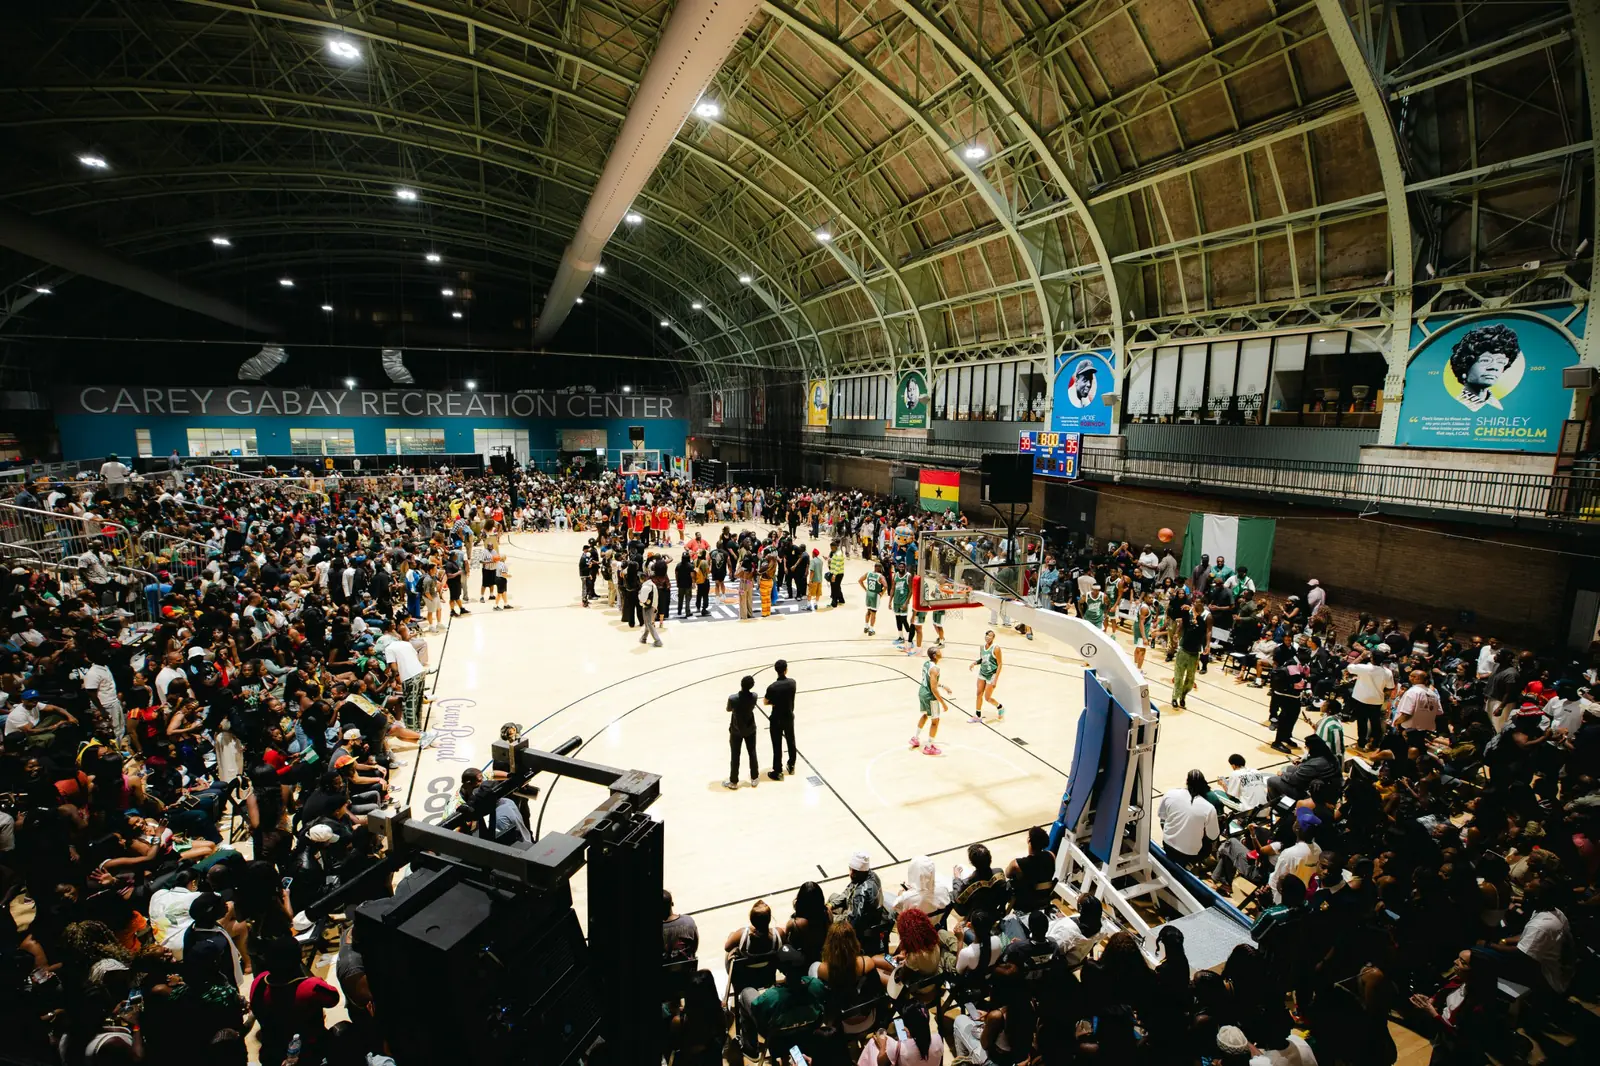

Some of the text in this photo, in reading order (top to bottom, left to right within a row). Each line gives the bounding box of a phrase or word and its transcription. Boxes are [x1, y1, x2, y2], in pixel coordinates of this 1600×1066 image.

[79, 387, 674, 418] CAREY GABAY RECREATION CENTER
[1476, 416, 1531, 426] SHIRLEY
[1474, 426, 1548, 438] CHISHOLM
[1021, 438, 1030, 450] 39
[1041, 433, 1058, 446] 8:00
[1066, 440, 1078, 454] 35
